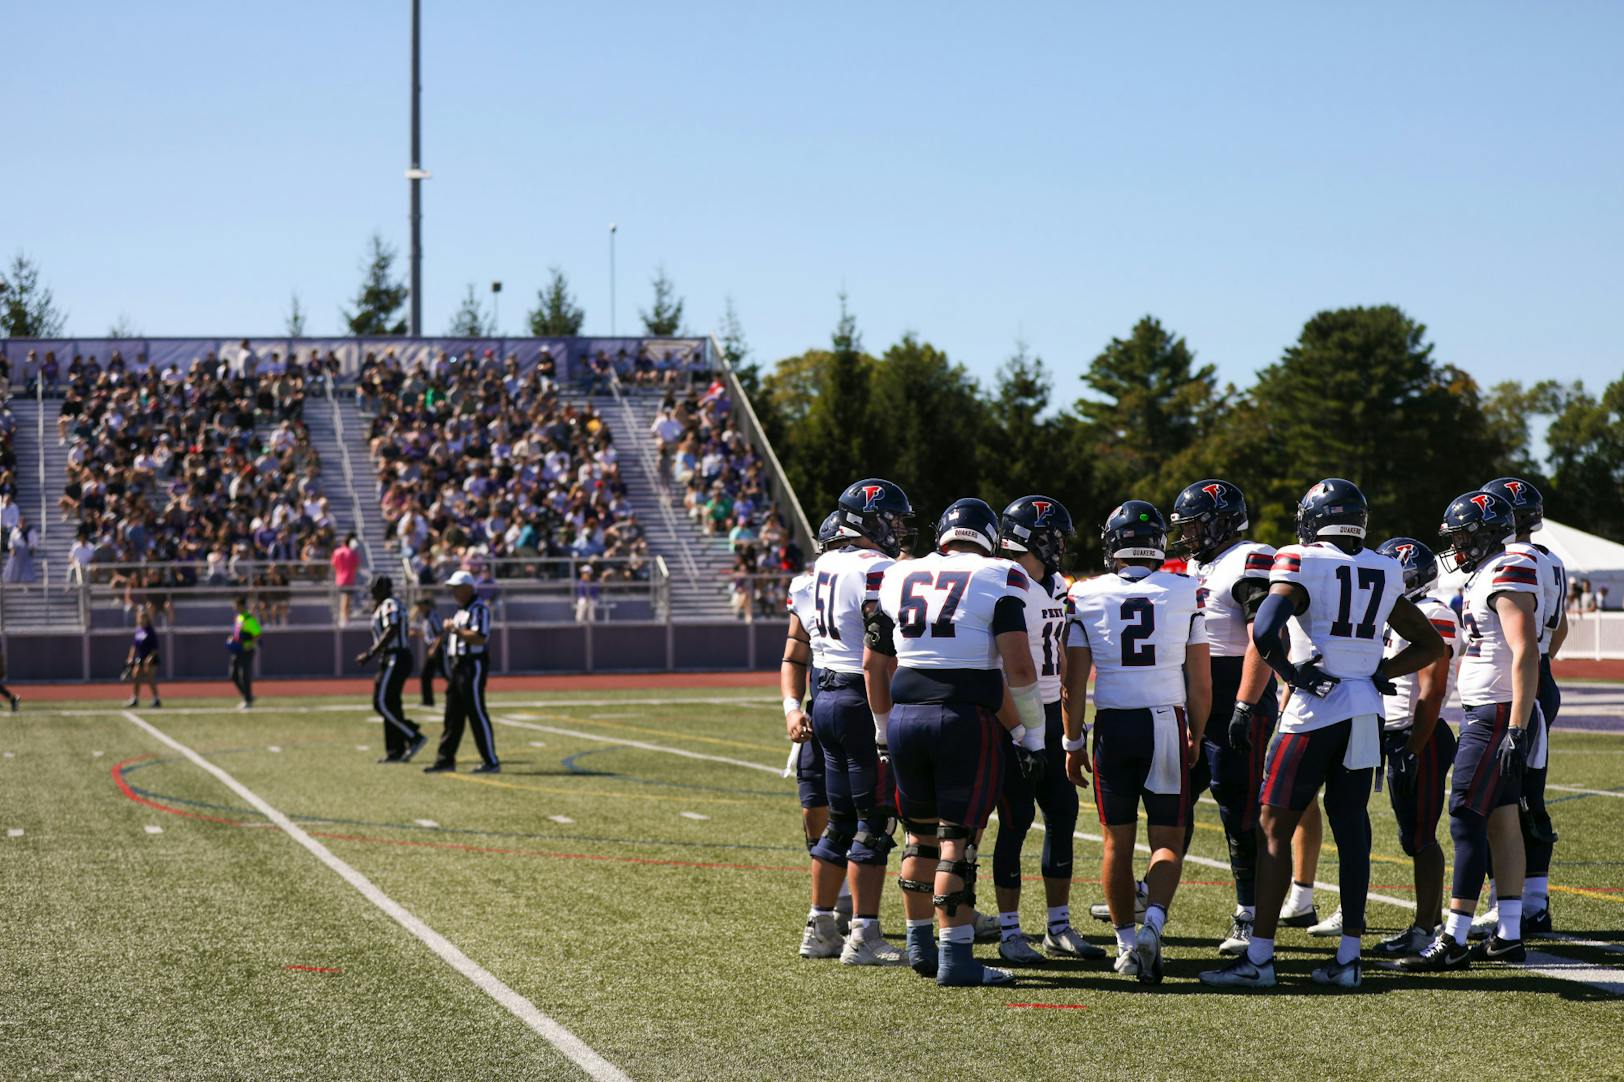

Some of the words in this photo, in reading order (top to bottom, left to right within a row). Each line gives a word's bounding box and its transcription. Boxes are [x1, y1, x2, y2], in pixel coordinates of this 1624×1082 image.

[815, 571, 842, 640] 51
[898, 571, 972, 638] 67
[1120, 597, 1156, 667] 2
[1329, 565, 1386, 639] 17
